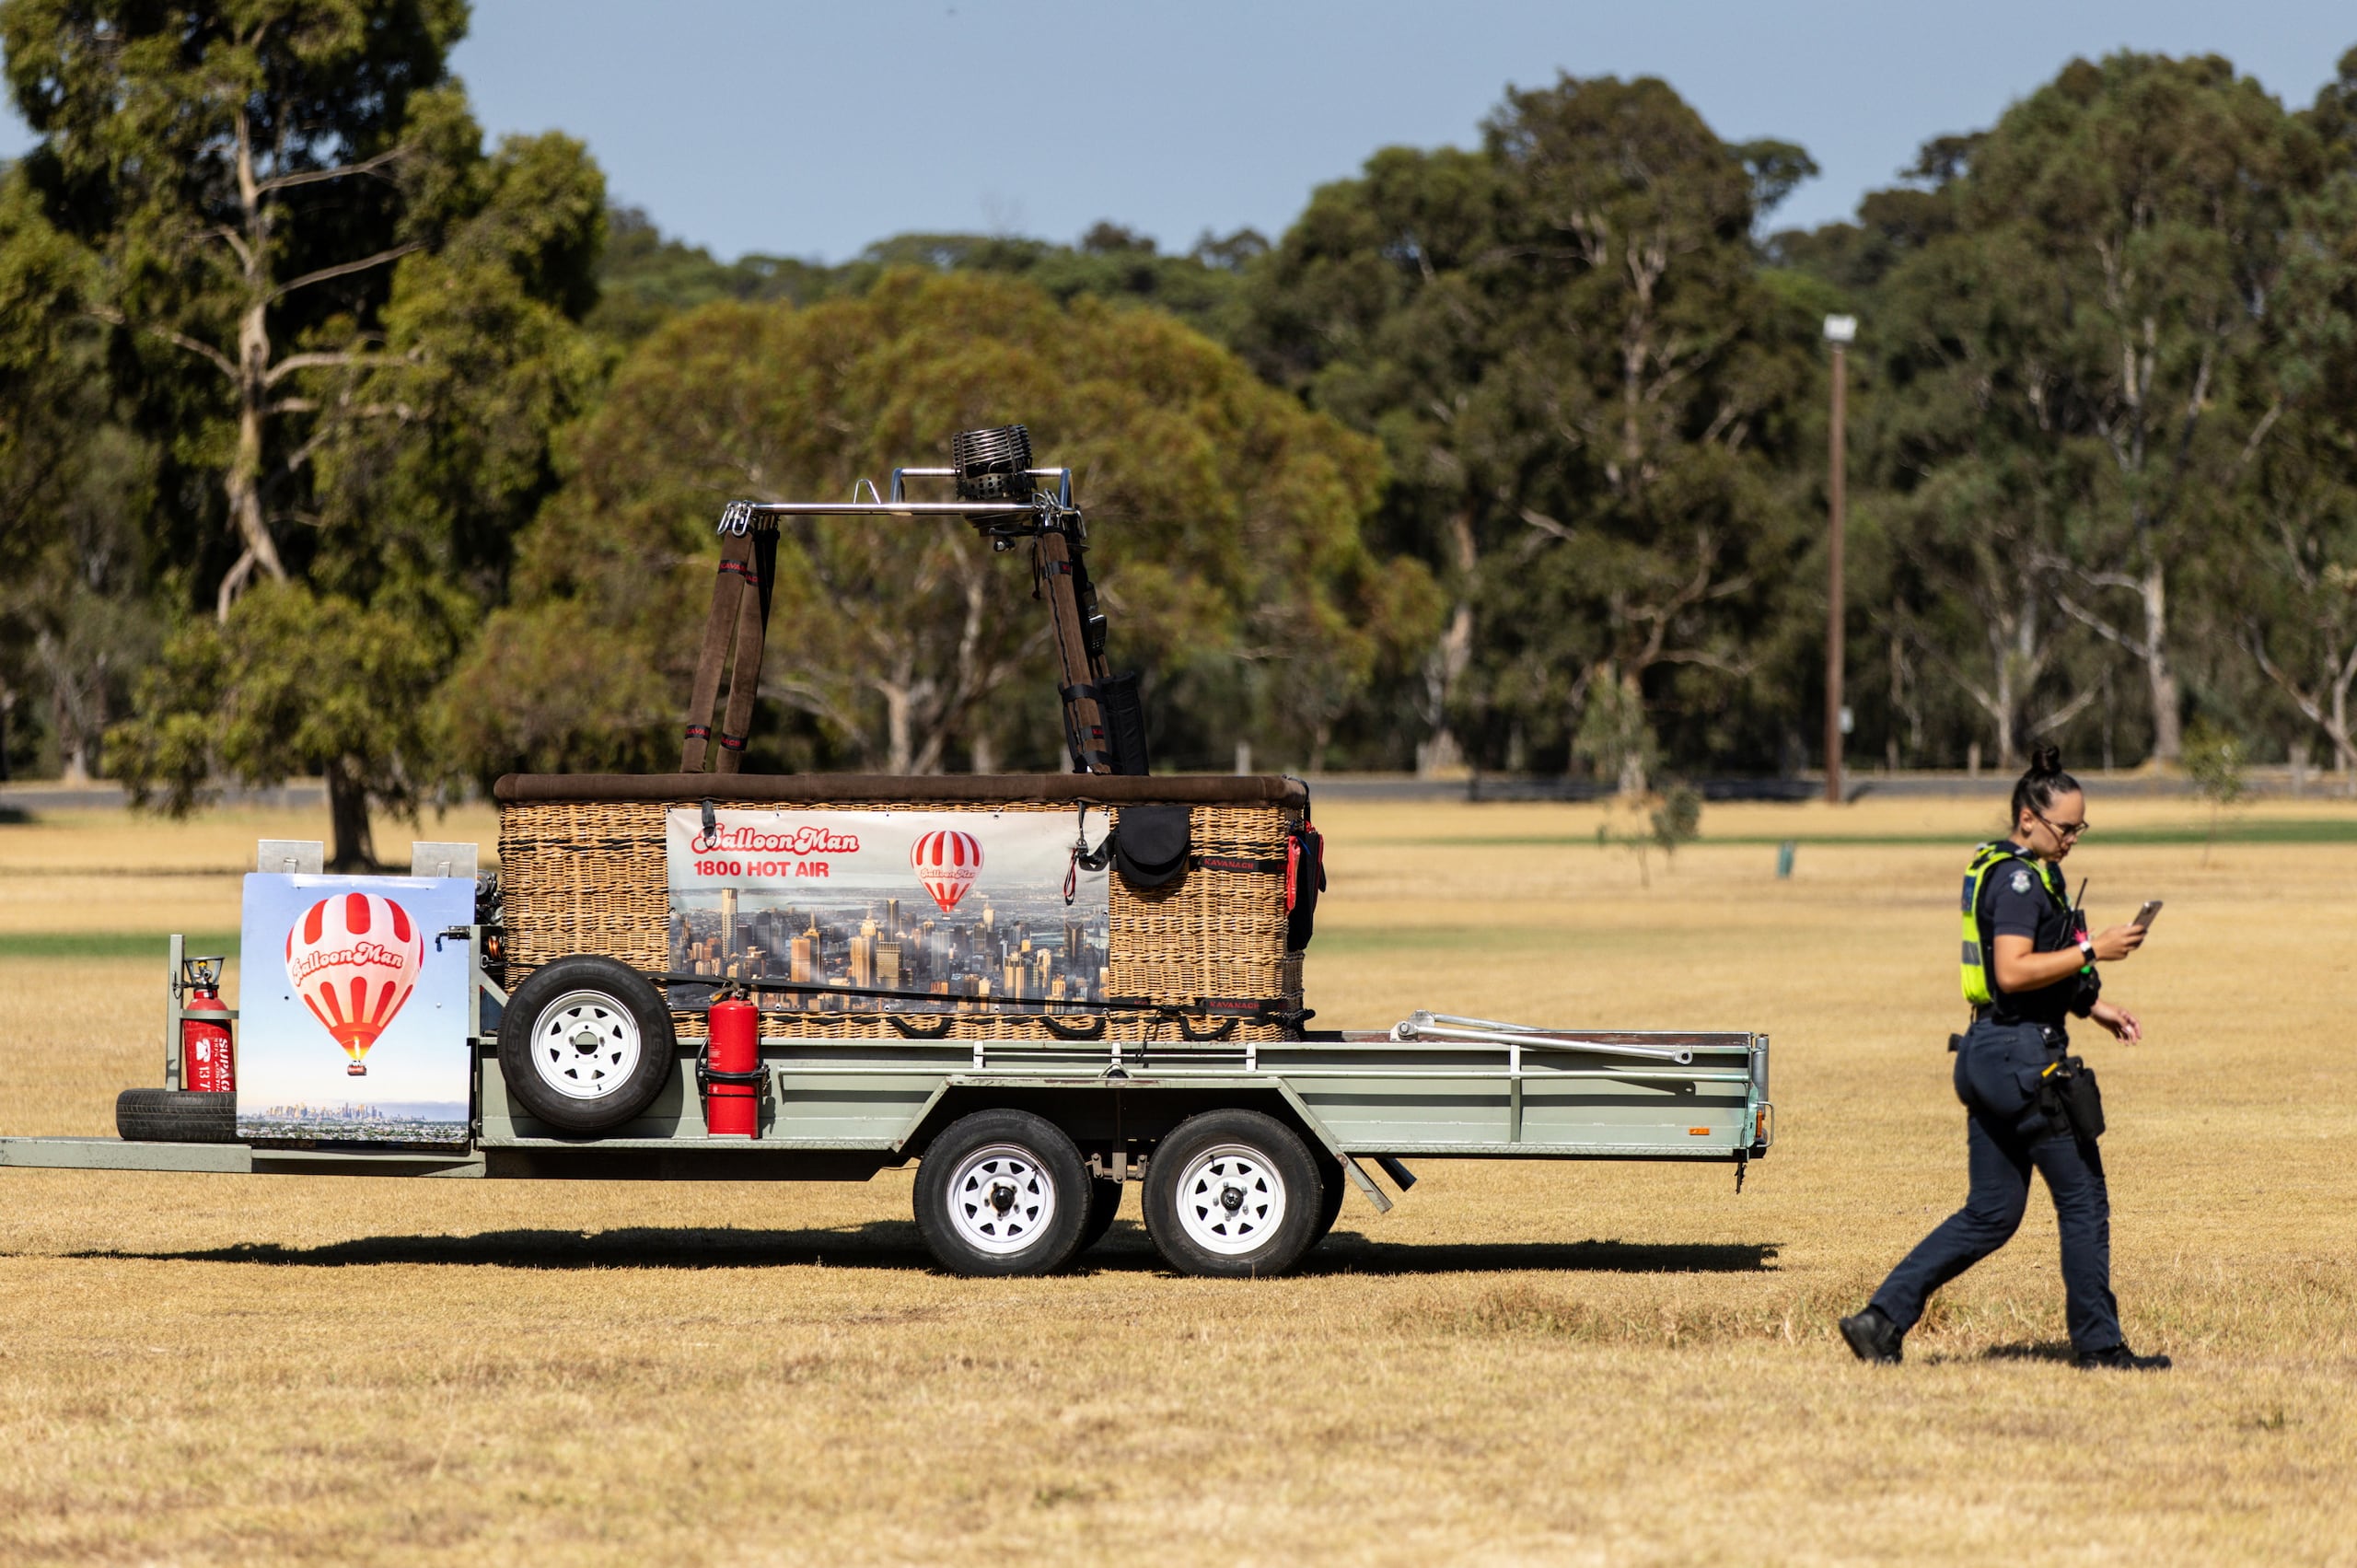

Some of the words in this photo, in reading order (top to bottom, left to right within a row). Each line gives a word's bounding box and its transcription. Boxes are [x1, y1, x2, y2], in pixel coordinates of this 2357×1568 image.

[693, 860, 742, 877] 1800
[747, 861, 791, 877] HOT
[795, 861, 830, 877] AIR
